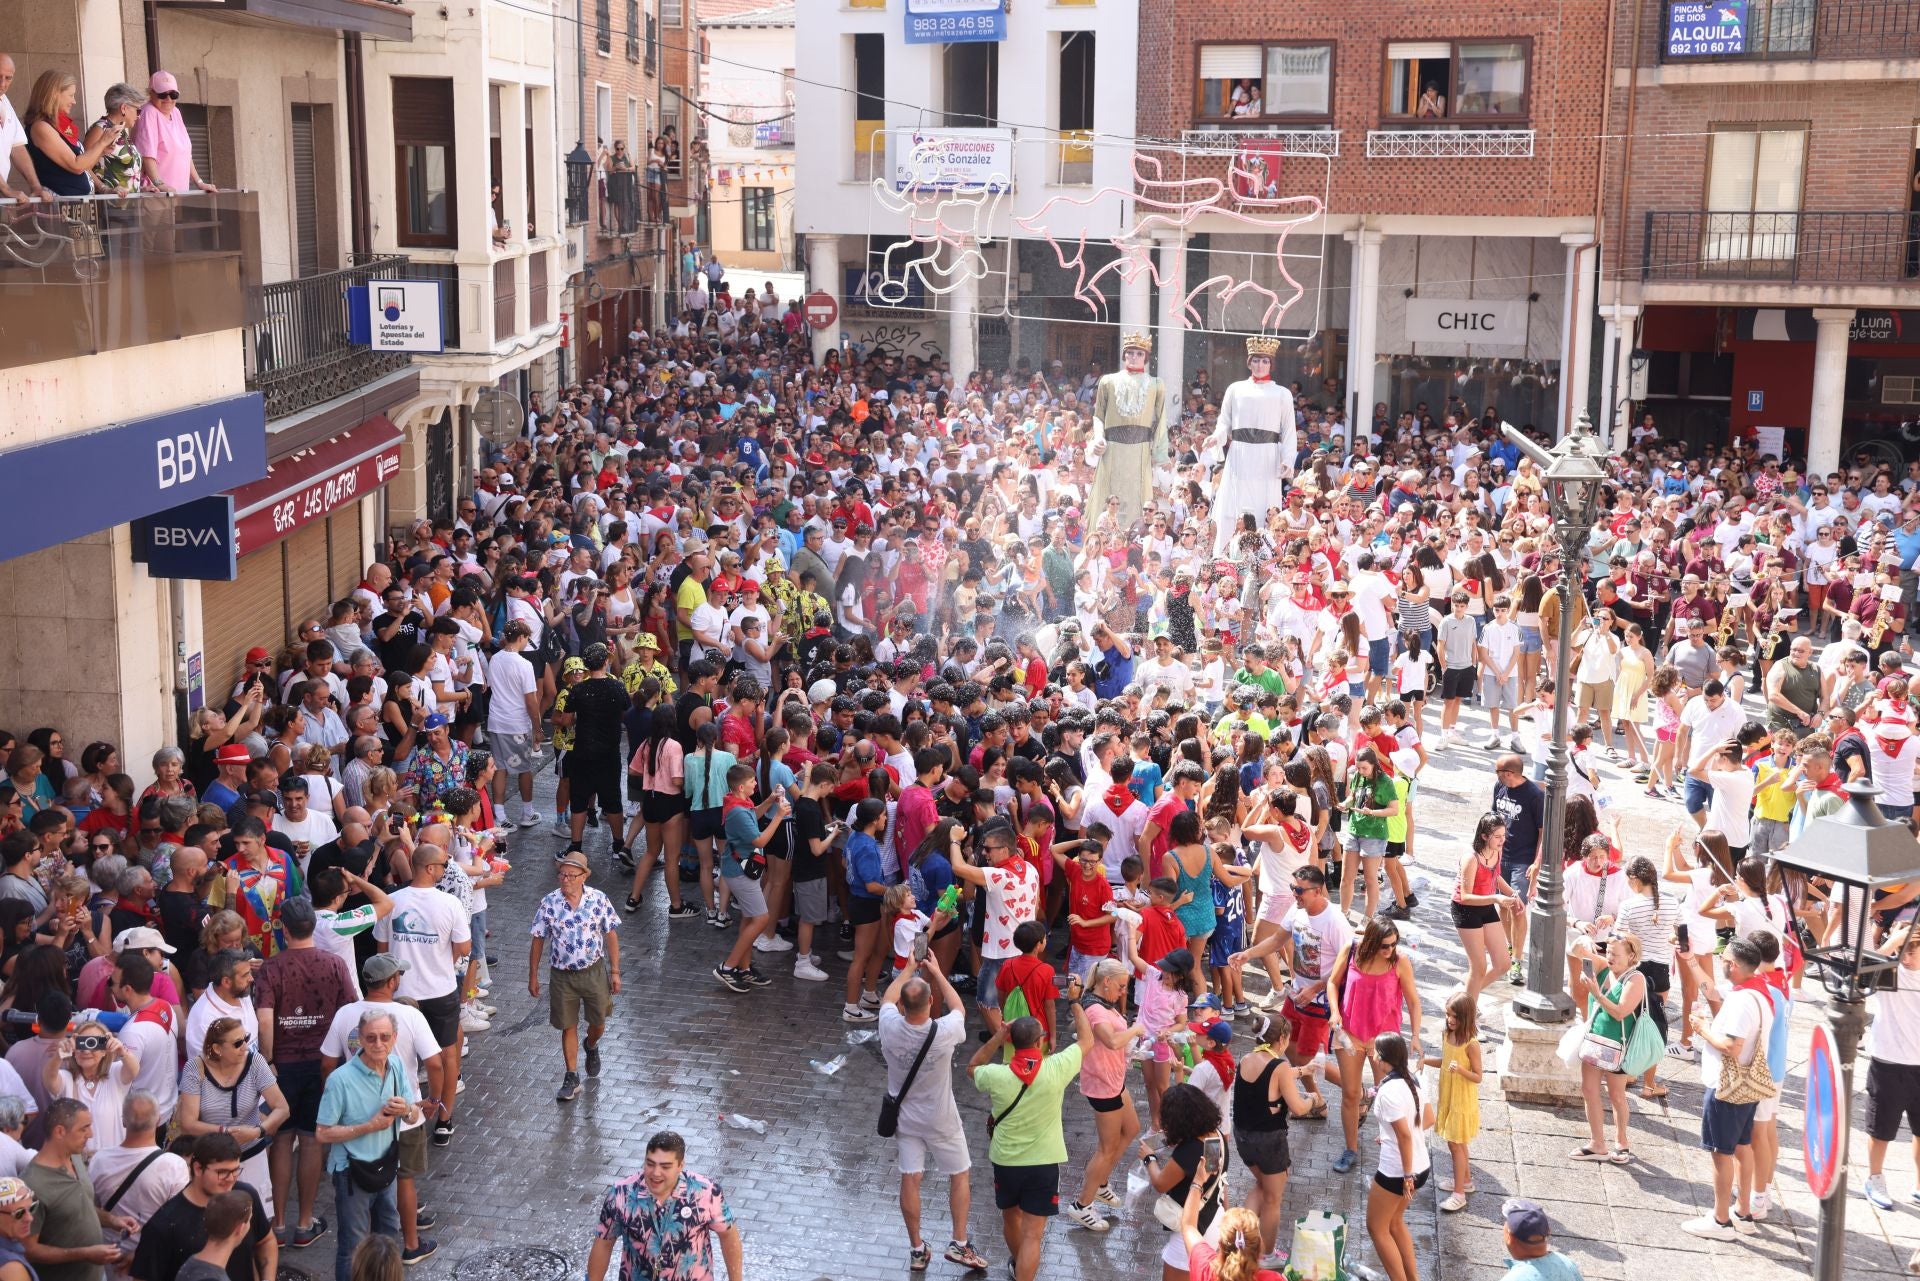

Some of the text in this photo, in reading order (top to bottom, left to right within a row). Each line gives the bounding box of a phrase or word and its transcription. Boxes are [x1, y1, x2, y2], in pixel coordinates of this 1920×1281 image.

[1674, 5, 1703, 14] FINCAS
[914, 16, 994, 30] 983 23 46 95
[1687, 14, 1706, 22] DIOS
[1671, 25, 1742, 41] ALQUILA
[1671, 41, 1741, 54] 692 10 60 74
[948, 153, 991, 164] González
[1438, 312, 1495, 331] CHIC
[1862, 318, 1892, 328] LUNA
[1849, 328, 1891, 340] afé-bar
[1752, 393, 1760, 405] B
[157, 417, 233, 490] BBVA
[273, 501, 296, 532] BAR
[154, 526, 222, 547] BBVA
[1227, 892, 1243, 922] 20
[393, 934, 438, 945] QUIKSILVER
